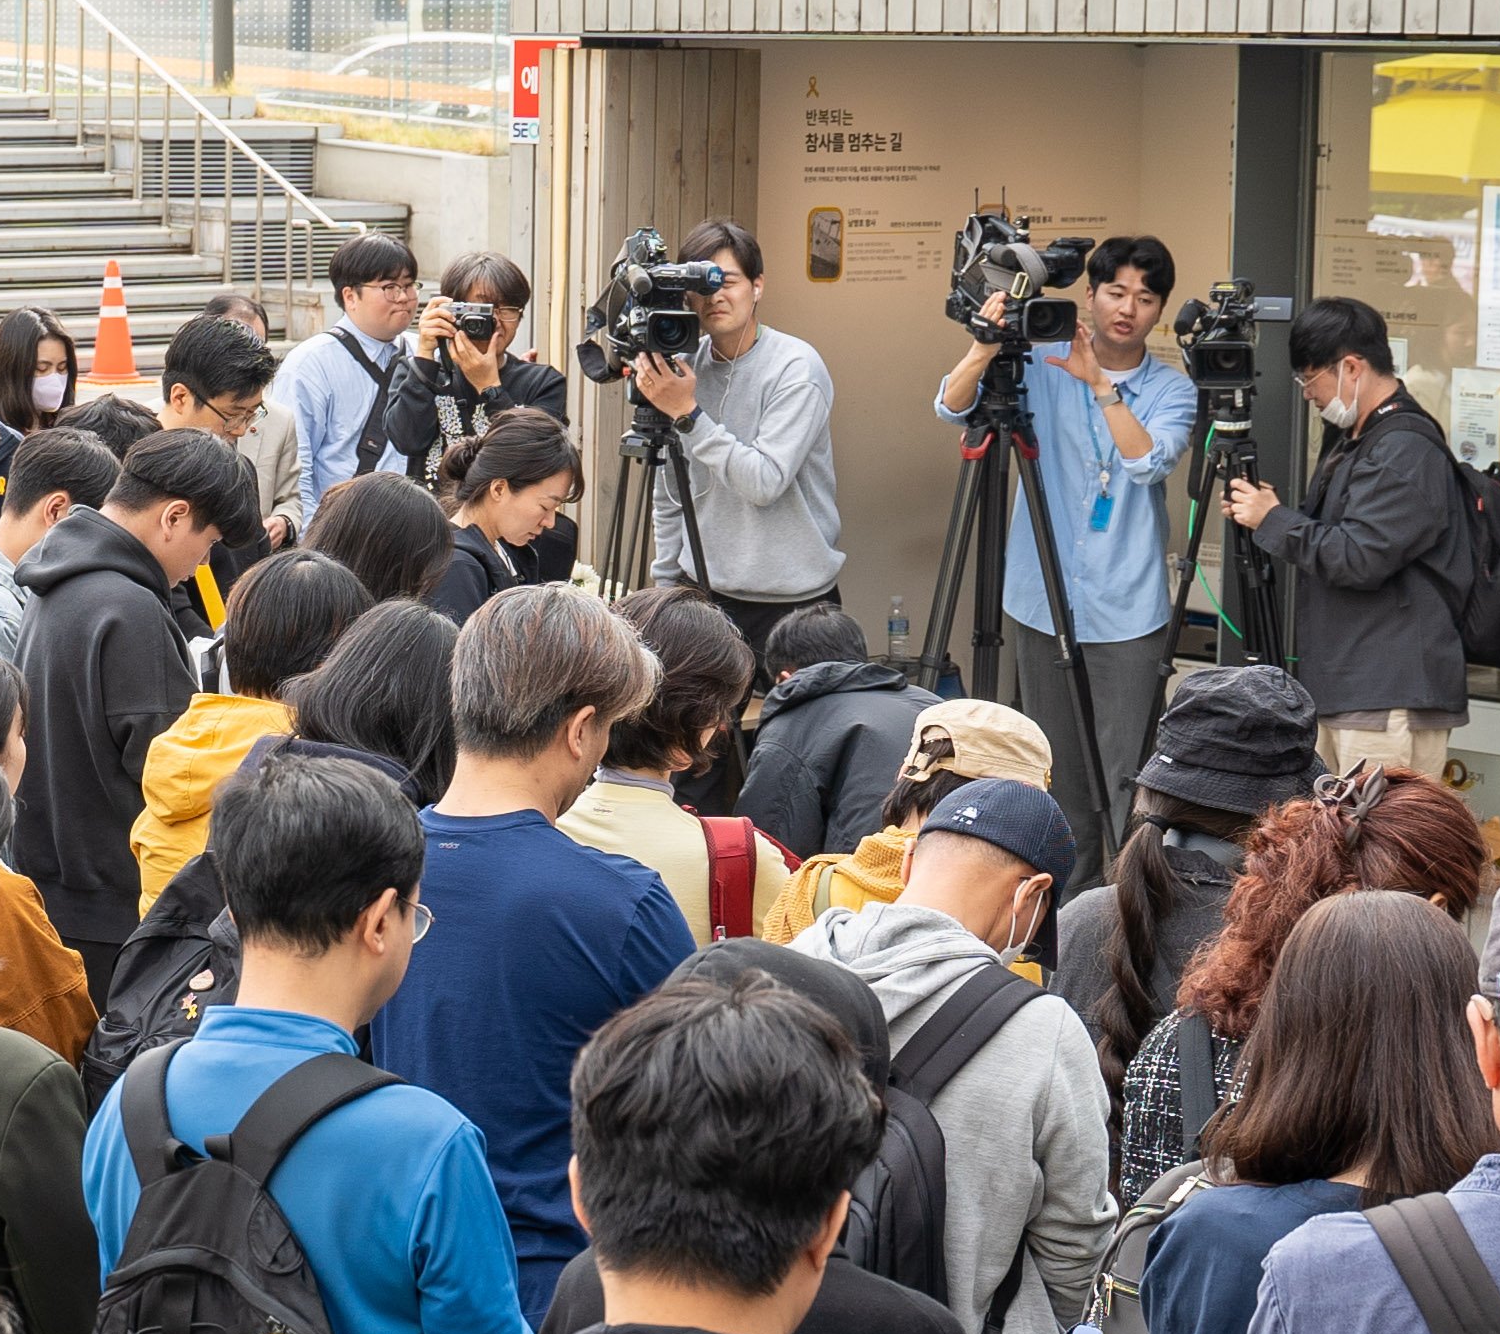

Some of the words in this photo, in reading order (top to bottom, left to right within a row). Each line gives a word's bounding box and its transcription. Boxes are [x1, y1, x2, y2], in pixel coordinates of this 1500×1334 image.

[805, 109, 854, 126] 반복되는
[513, 123, 540, 139] SEC
[805, 133, 845, 153] 참사를
[848, 133, 887, 152] 멈추는
[890, 132, 903, 152] 길
